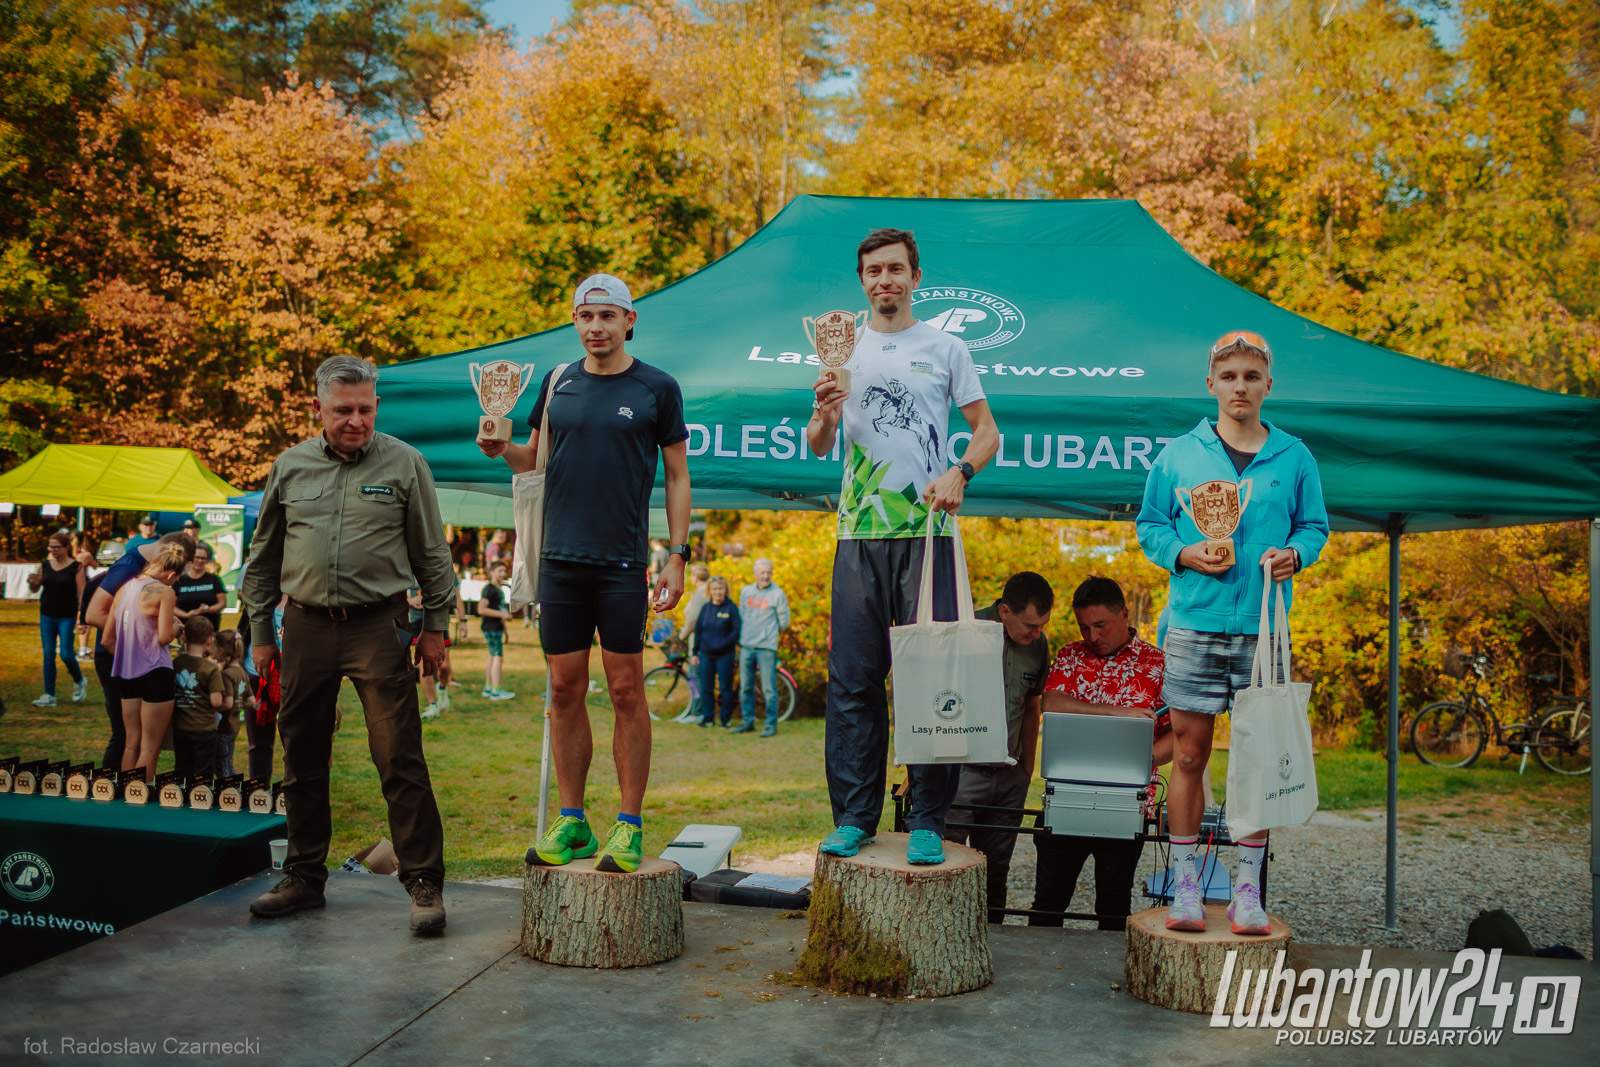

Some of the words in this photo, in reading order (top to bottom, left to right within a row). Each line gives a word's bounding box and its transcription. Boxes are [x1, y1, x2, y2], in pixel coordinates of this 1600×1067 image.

[919, 288, 1019, 322] PAŃSTWOWE
[748, 346, 820, 366] Las
[974, 362, 1145, 378] stwowe
[911, 725, 934, 736] Lasy
[936, 725, 989, 735] Państwowe
